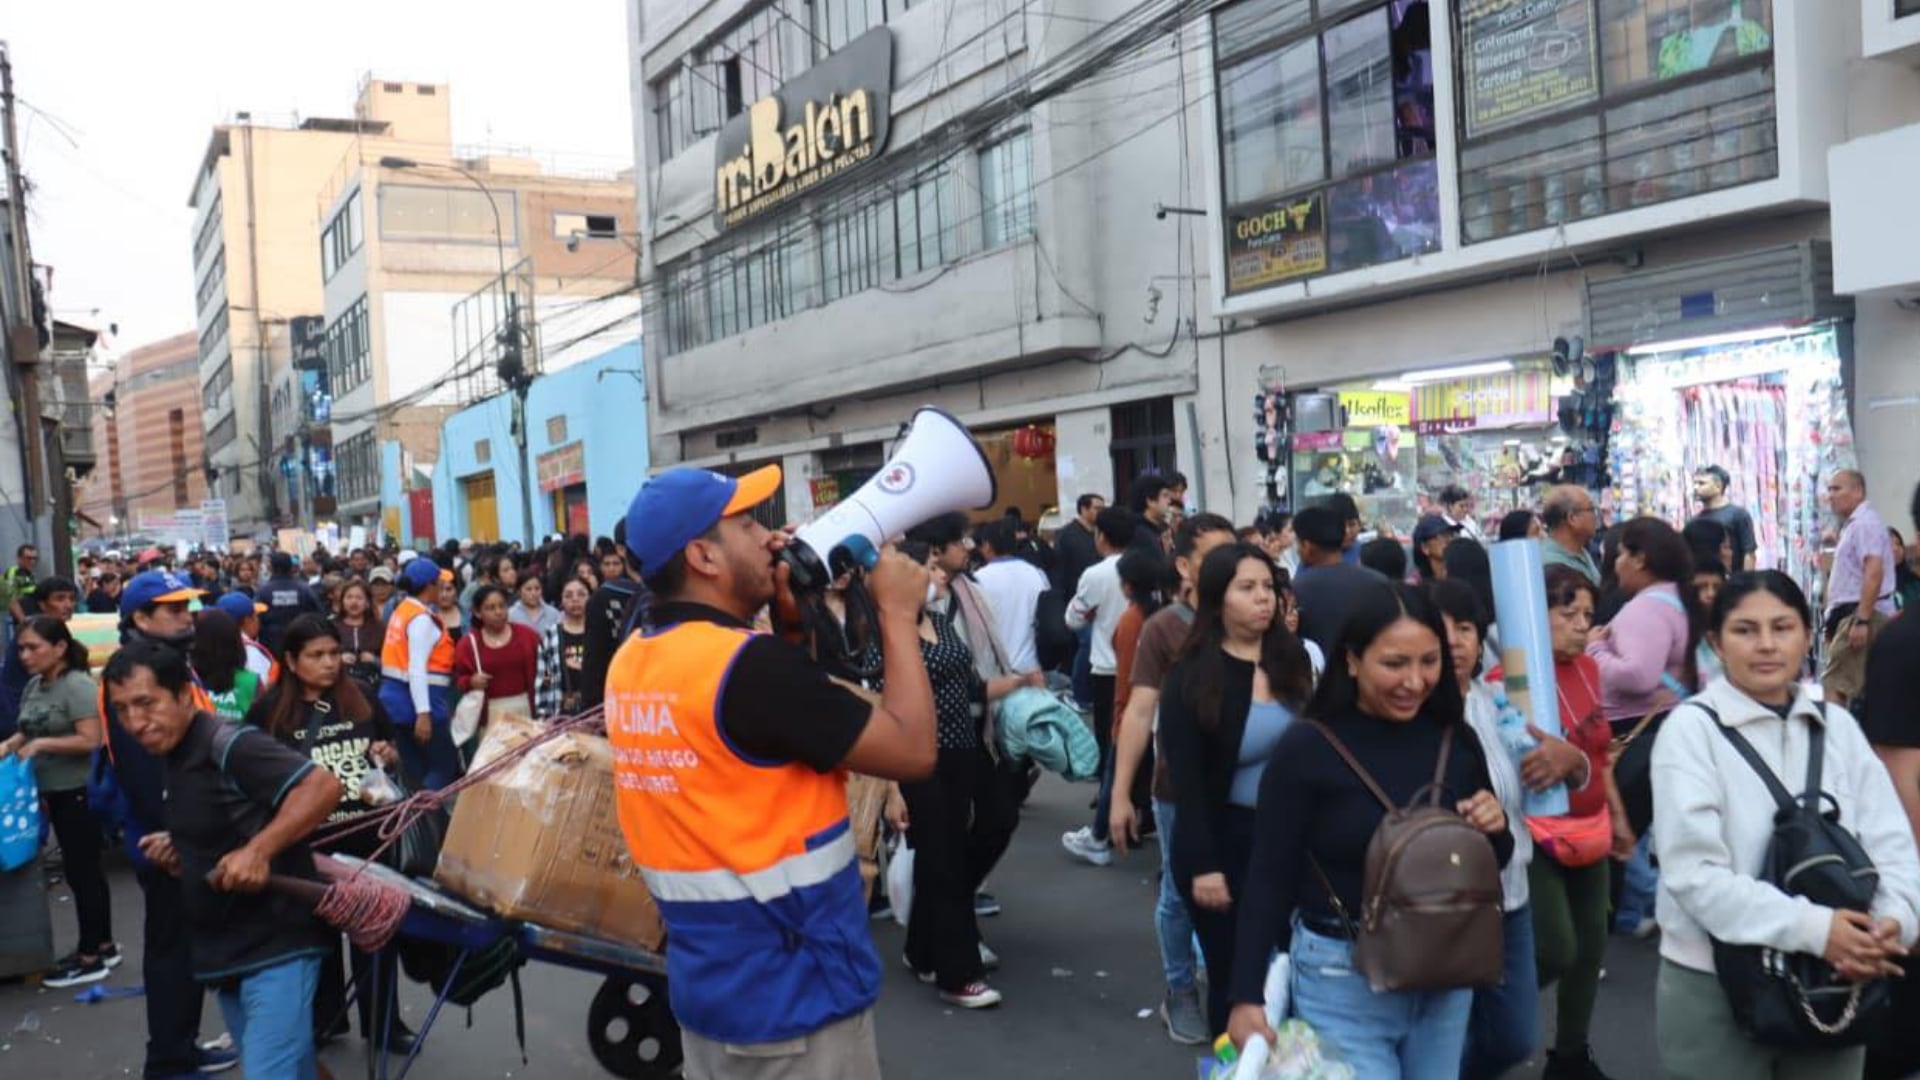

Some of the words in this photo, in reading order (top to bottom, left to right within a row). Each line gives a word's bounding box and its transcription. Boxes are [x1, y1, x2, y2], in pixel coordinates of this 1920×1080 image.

[1474, 26, 1534, 53] Cinturones
[1477, 67, 1522, 91] Carteras
[1237, 209, 1287, 239] GOCH
[619, 702, 680, 737] LIMA
